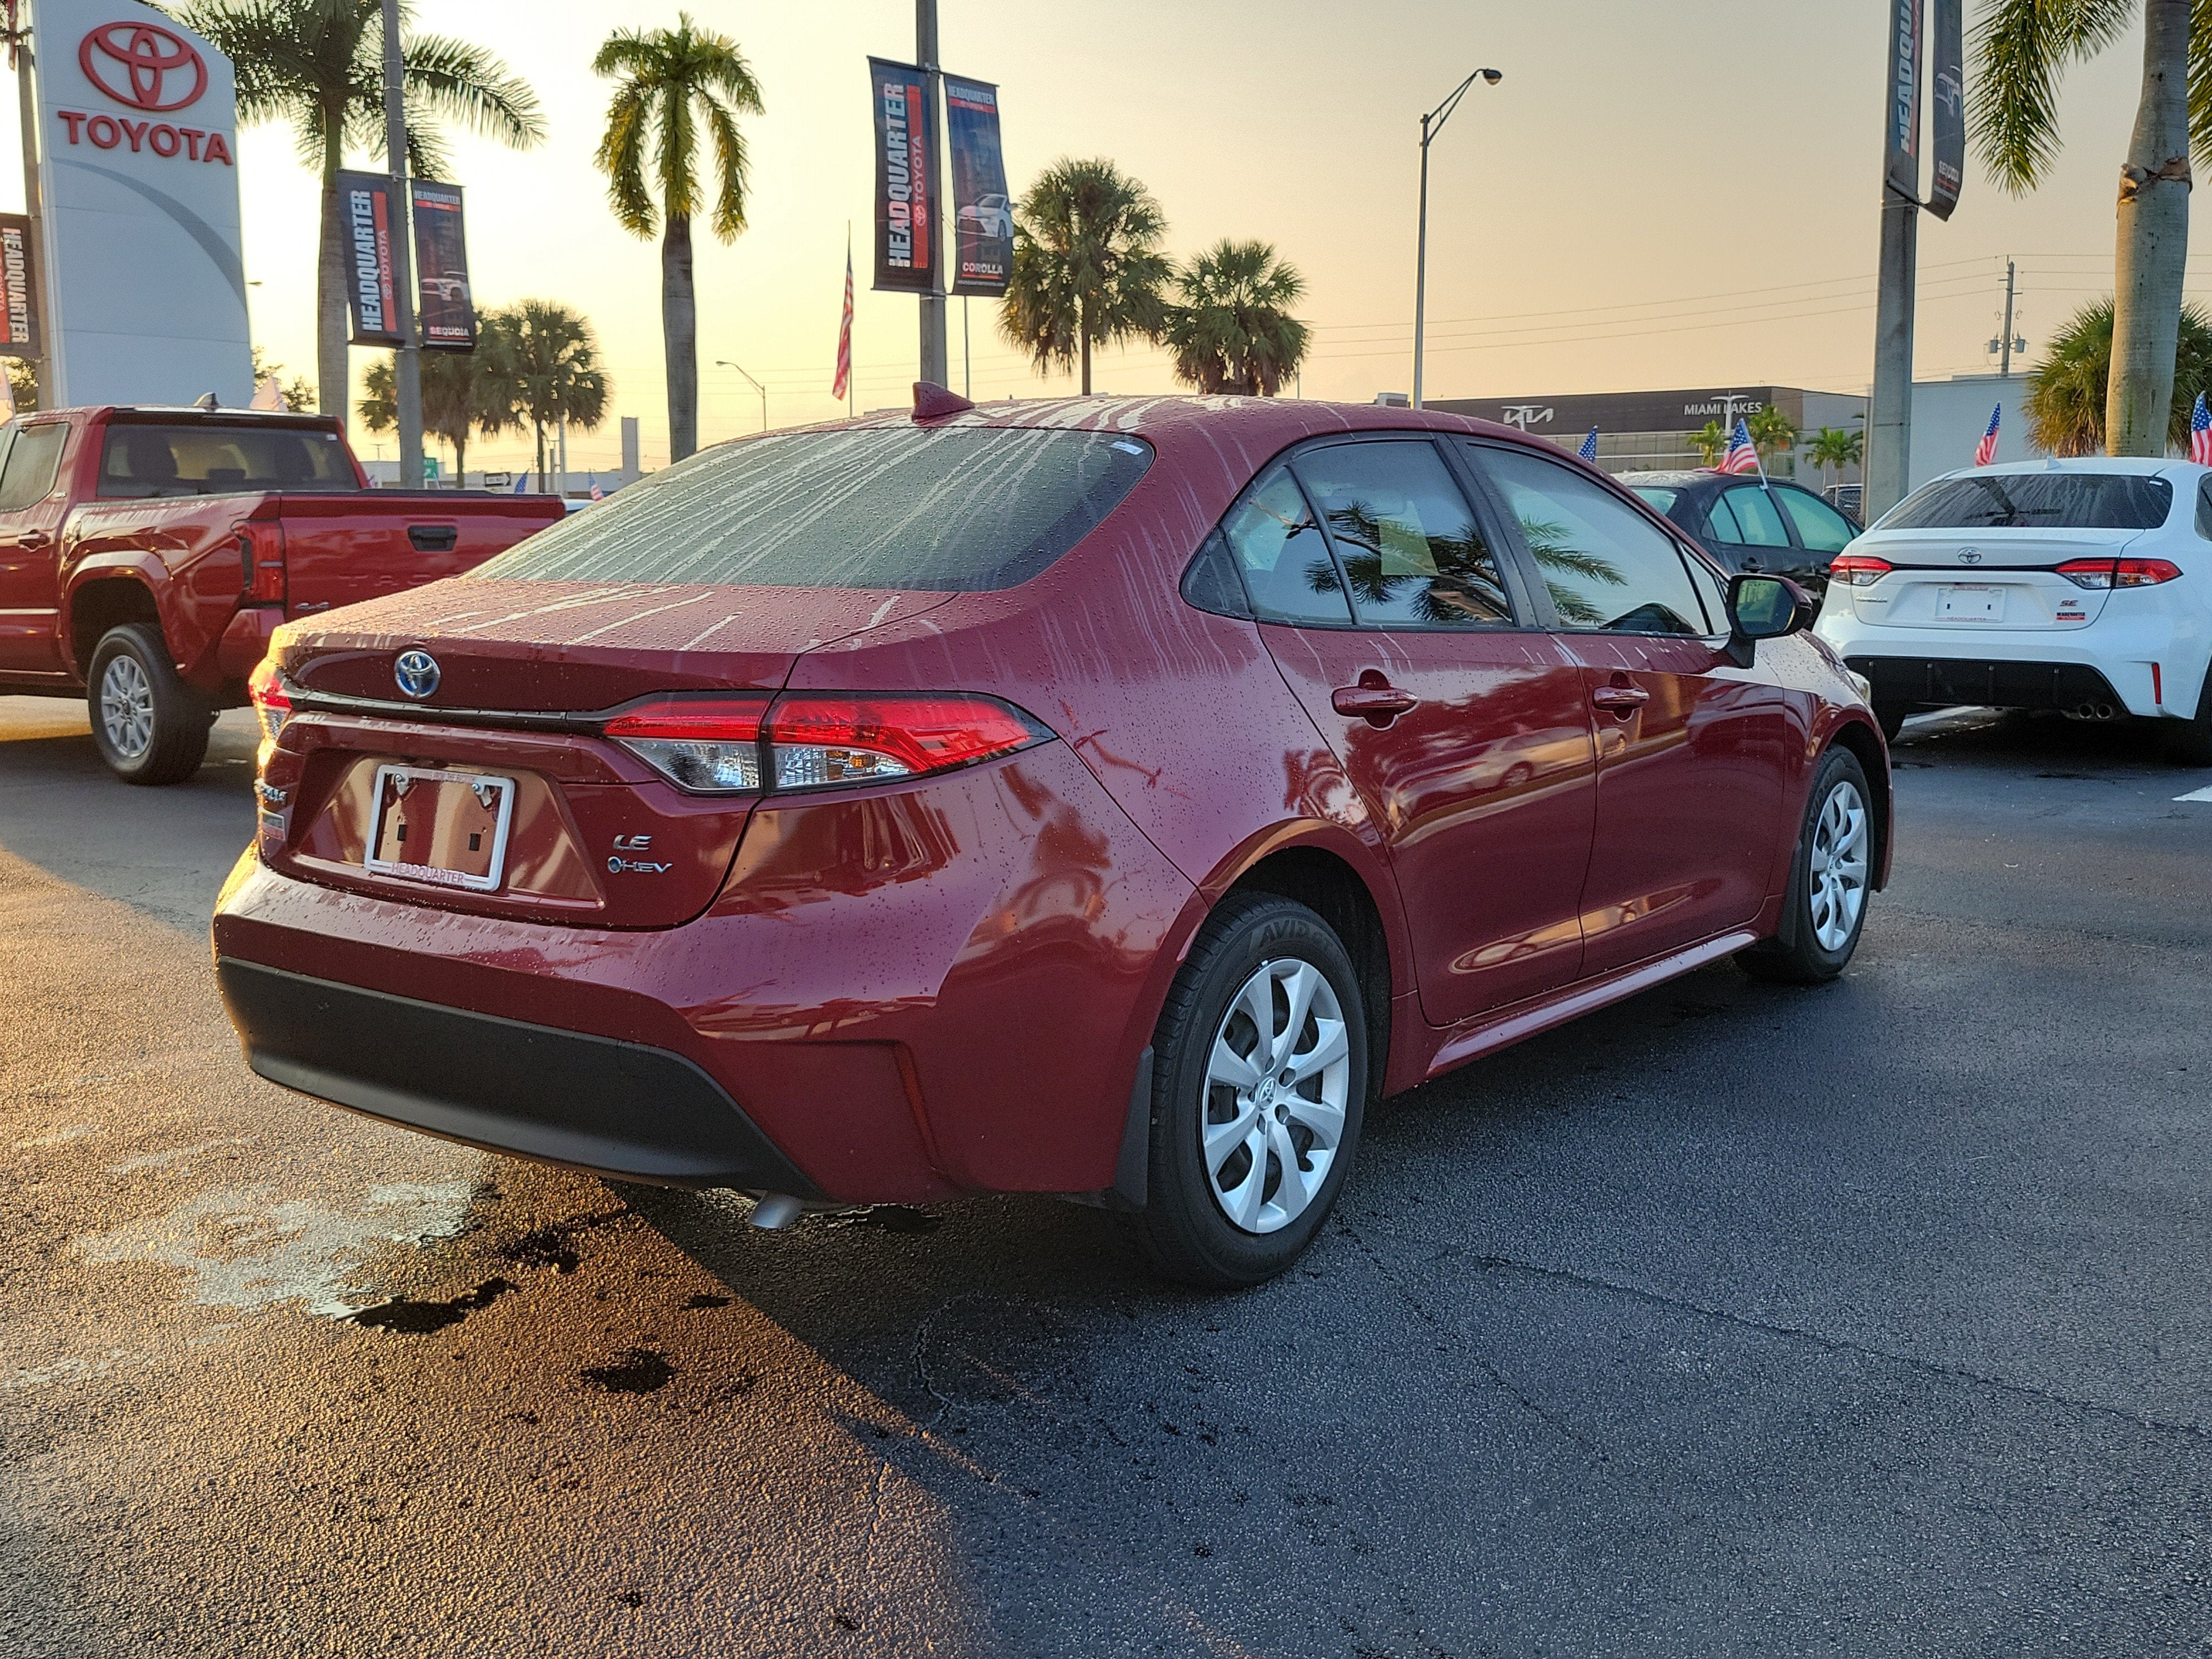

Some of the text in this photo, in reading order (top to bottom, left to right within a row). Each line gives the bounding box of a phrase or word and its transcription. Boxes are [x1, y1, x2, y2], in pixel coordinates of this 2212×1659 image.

[58, 110, 234, 166] TOYOTA
[883, 82, 912, 268] HEADQUARTER
[912, 136, 924, 204] TOYOTA
[350, 191, 383, 331] HEADQUARTER
[377, 230, 391, 282] TOYOTA
[962, 262, 1003, 274] COROLLA
[2, 227, 30, 343] HEADQUARTER
[429, 326, 470, 336] SEQUOIA
[1684, 402, 1763, 415] MIAMI LAKES
[613, 834, 652, 851] LE
[392, 863, 465, 884] HEADQUARTER
[1258, 919, 1310, 947] AVID
